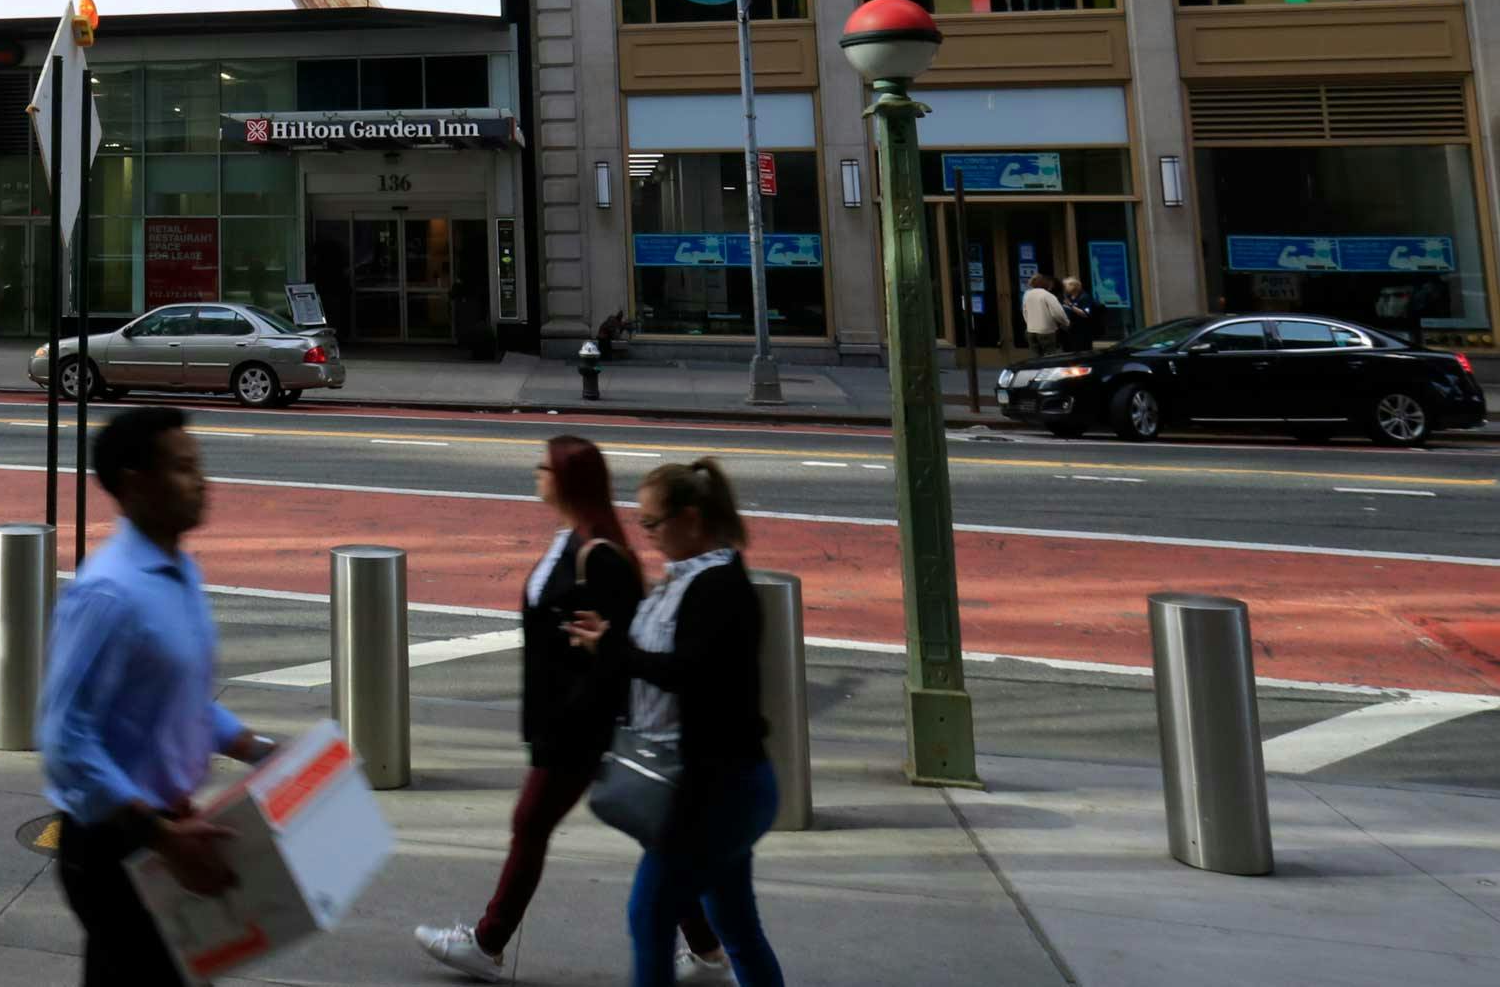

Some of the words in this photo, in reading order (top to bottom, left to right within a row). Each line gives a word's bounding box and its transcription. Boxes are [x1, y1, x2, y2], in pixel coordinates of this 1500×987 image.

[271, 120, 346, 140] Hilton
[349, 119, 432, 139] Garden
[438, 118, 480, 138] Inn
[377, 173, 412, 191] 136
